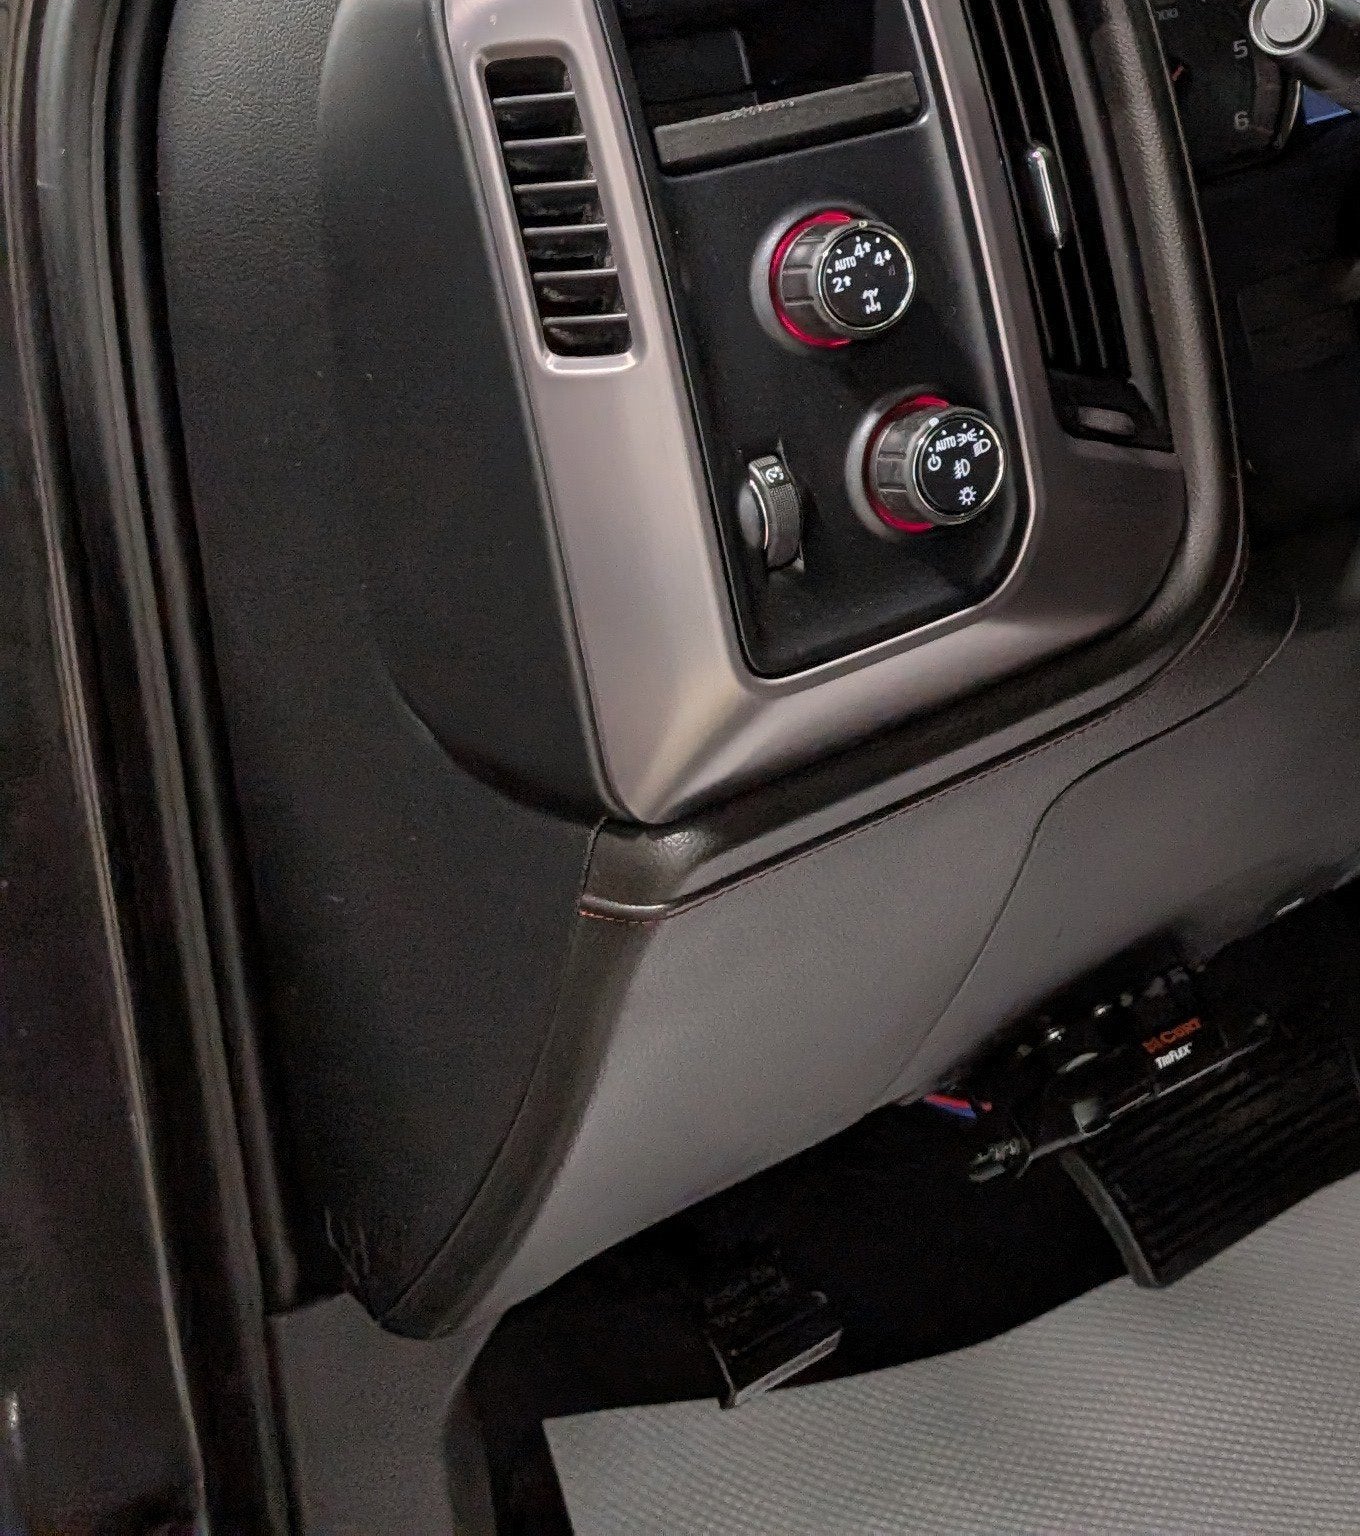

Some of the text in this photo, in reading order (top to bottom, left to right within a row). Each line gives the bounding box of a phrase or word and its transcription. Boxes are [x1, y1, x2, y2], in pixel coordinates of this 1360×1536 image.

[1232, 40, 1249, 59] 5
[1233, 111, 1250, 130] 6
[854, 243, 865, 258] 4
[874, 251, 885, 266] 4
[834, 256, 857, 272] AUTO
[832, 277, 844, 293] 2
[935, 435, 957, 453] AUTO
